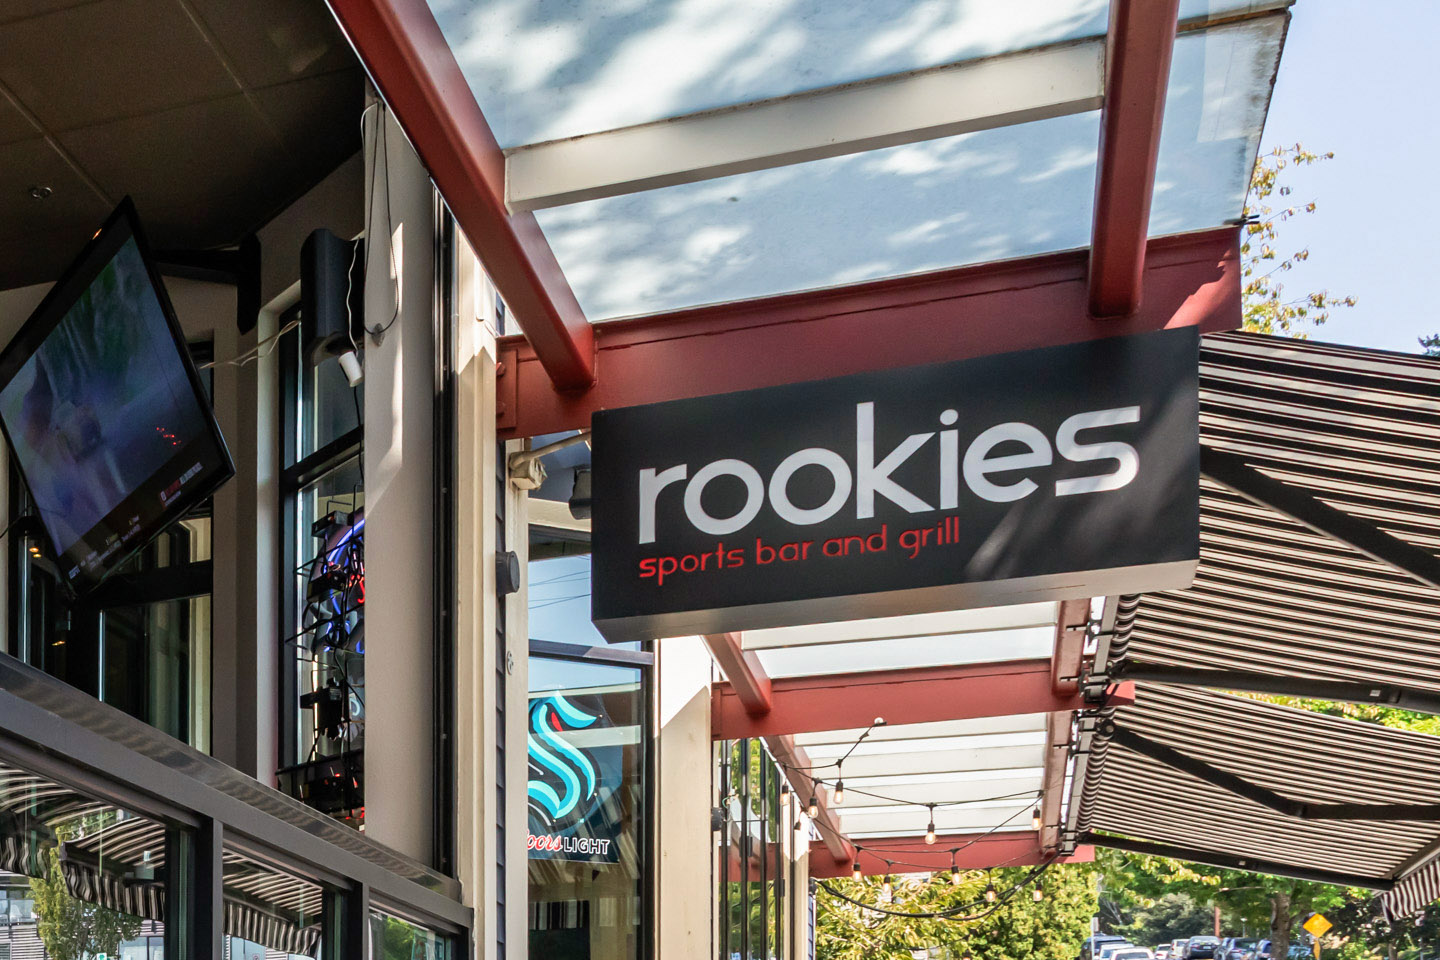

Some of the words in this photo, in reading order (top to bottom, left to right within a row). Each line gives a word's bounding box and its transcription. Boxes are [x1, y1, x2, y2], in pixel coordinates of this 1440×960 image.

[638, 401, 1141, 545] rookies
[638, 541, 745, 586] sports
[755, 535, 808, 565] bar
[822, 523, 888, 559] and
[899, 515, 960, 560] grill
[527, 829, 563, 852] oors
[563, 836, 610, 855] LIGHT
